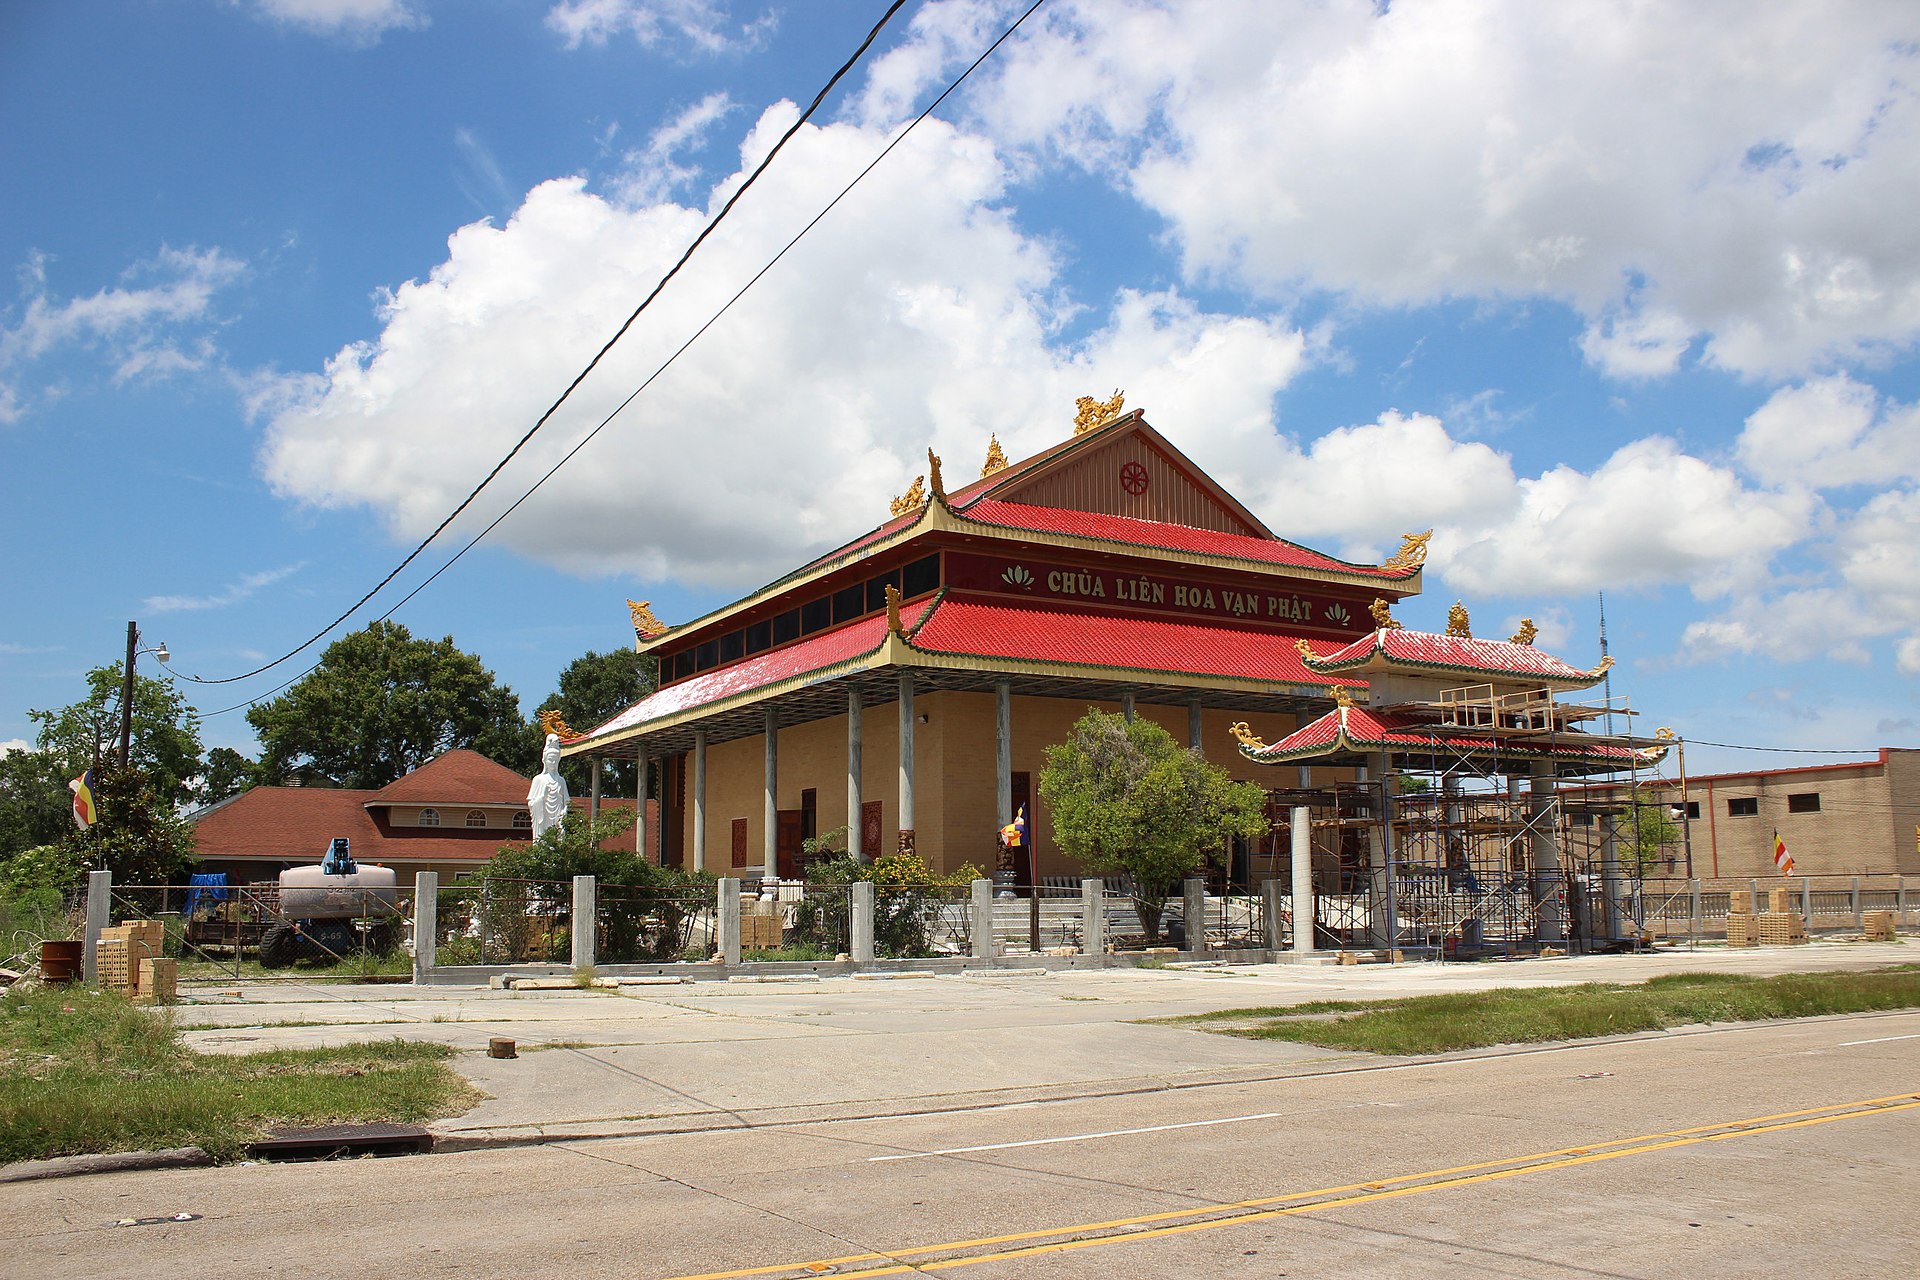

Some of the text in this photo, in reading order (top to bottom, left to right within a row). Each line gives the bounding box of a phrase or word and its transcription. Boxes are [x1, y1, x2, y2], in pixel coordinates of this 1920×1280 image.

[1047, 568, 1313, 623] CHÙA LIÊN HOA VẠN PHẬT
